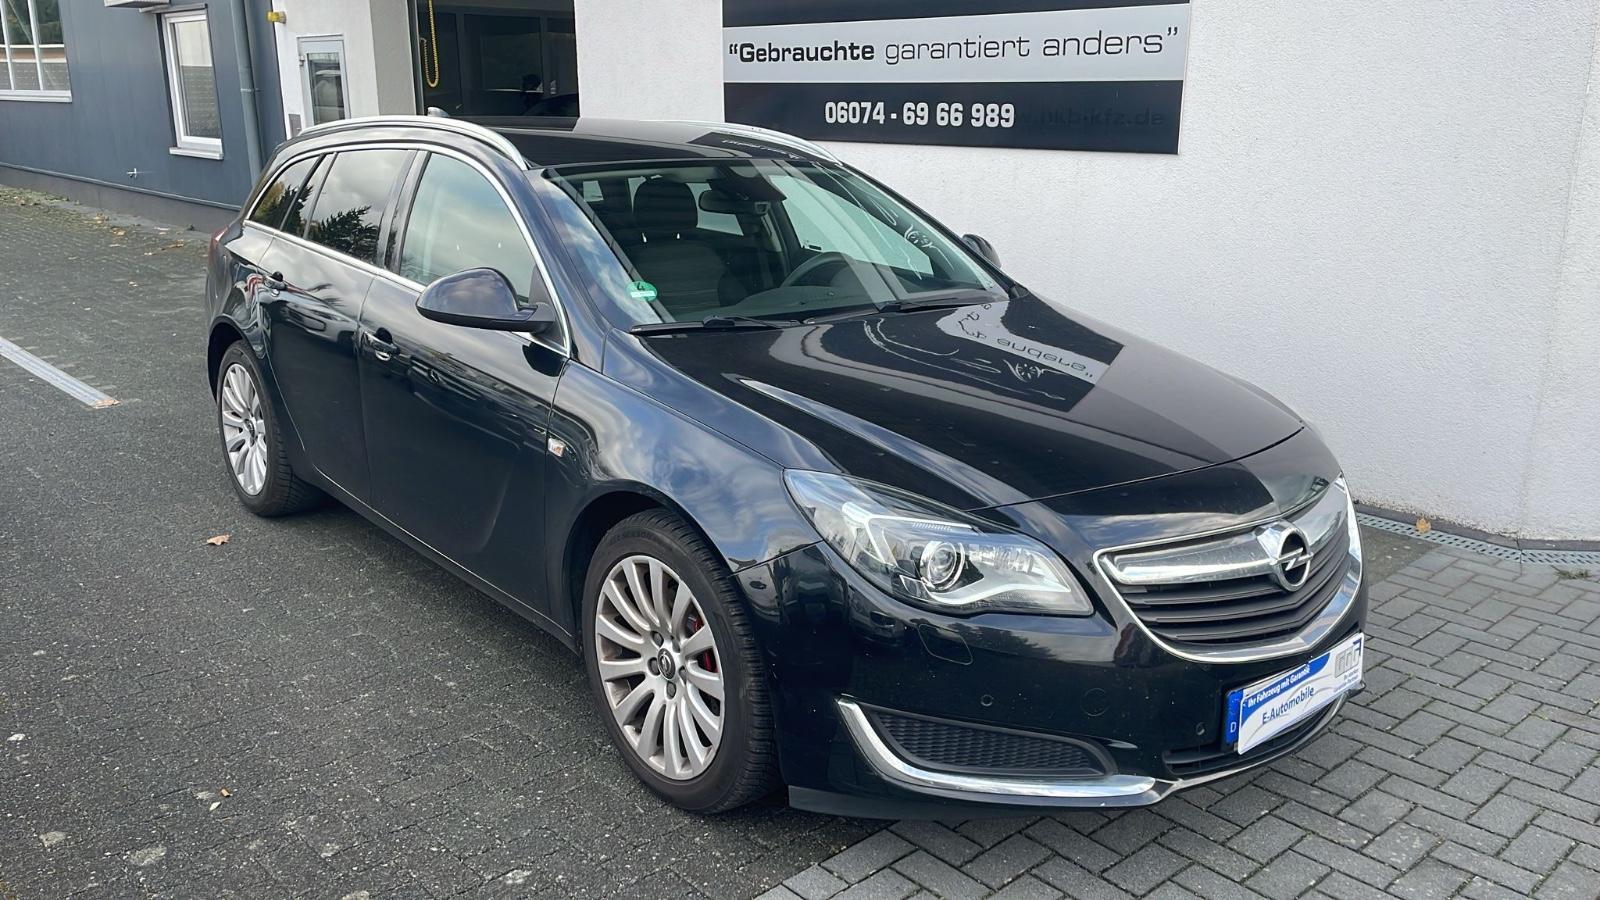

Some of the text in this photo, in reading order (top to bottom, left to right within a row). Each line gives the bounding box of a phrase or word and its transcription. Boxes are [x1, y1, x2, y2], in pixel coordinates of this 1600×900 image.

[728, 26, 1178, 66] “Gebrauchte garantiert anders”
[824, 101, 1015, 128] 06074 - 69 66 989
[1247, 696, 1257, 708] Ihr
[1256, 684, 1281, 703] Fahrzeug
[1280, 678, 1290, 690] mit
[1262, 686, 1315, 725] E-Automobile
[1230, 722, 1237, 733] D
